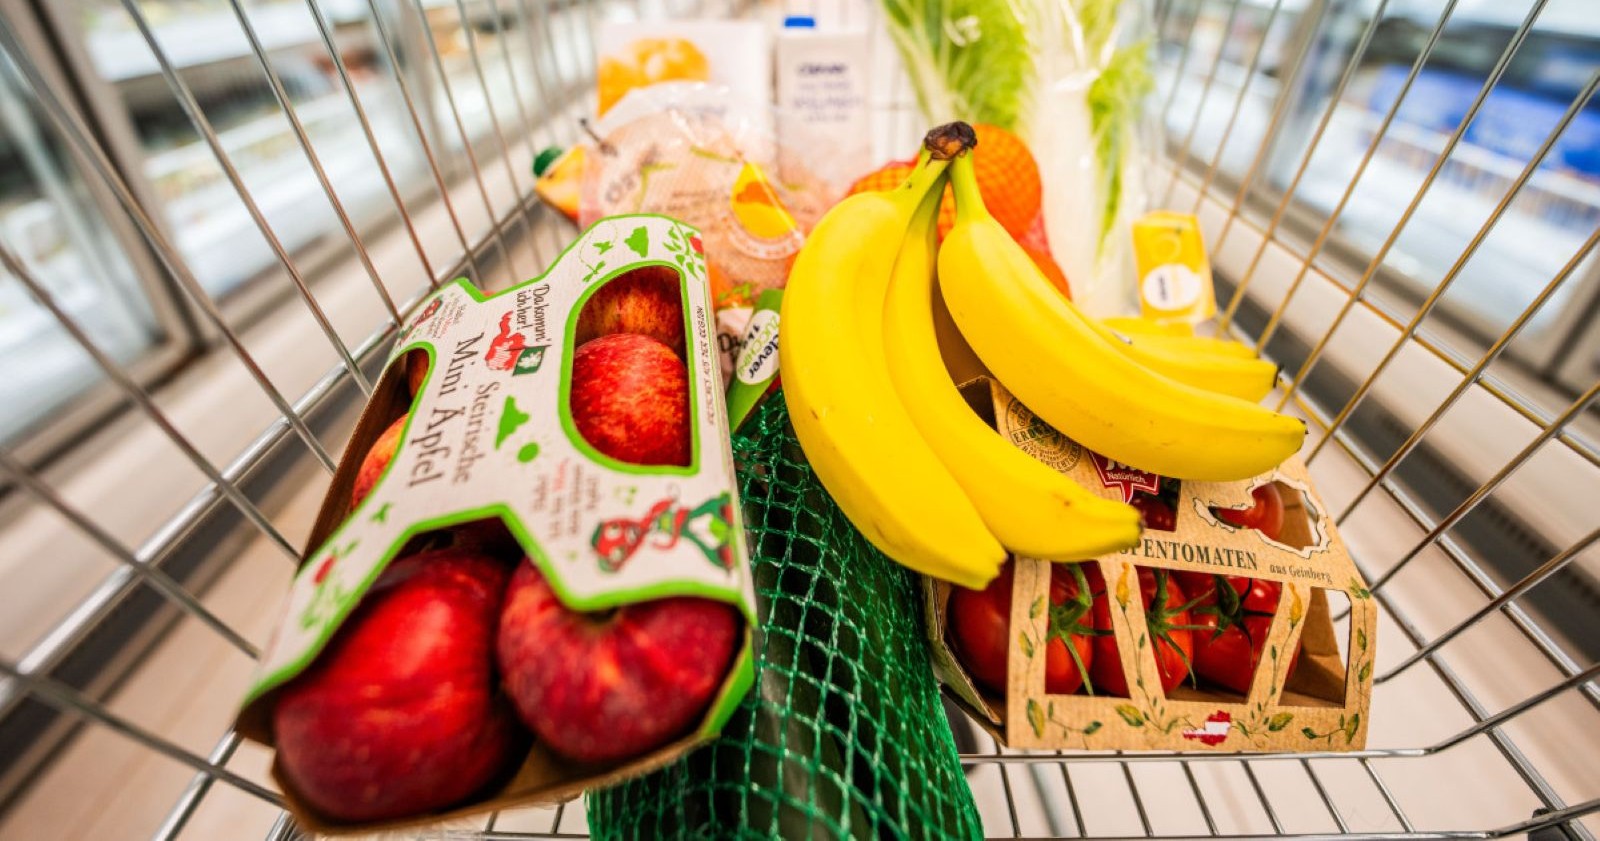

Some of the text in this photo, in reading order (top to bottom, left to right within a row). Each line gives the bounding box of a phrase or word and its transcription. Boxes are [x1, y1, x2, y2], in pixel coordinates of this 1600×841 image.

[516, 289, 533, 331] ich her!
[532, 282, 553, 343] Da komm'
[438, 331, 485, 397] Mini
[408, 405, 467, 488] Äpfel
[452, 380, 500, 484] Steirische
[1269, 563, 1334, 585] aus Geinberg
